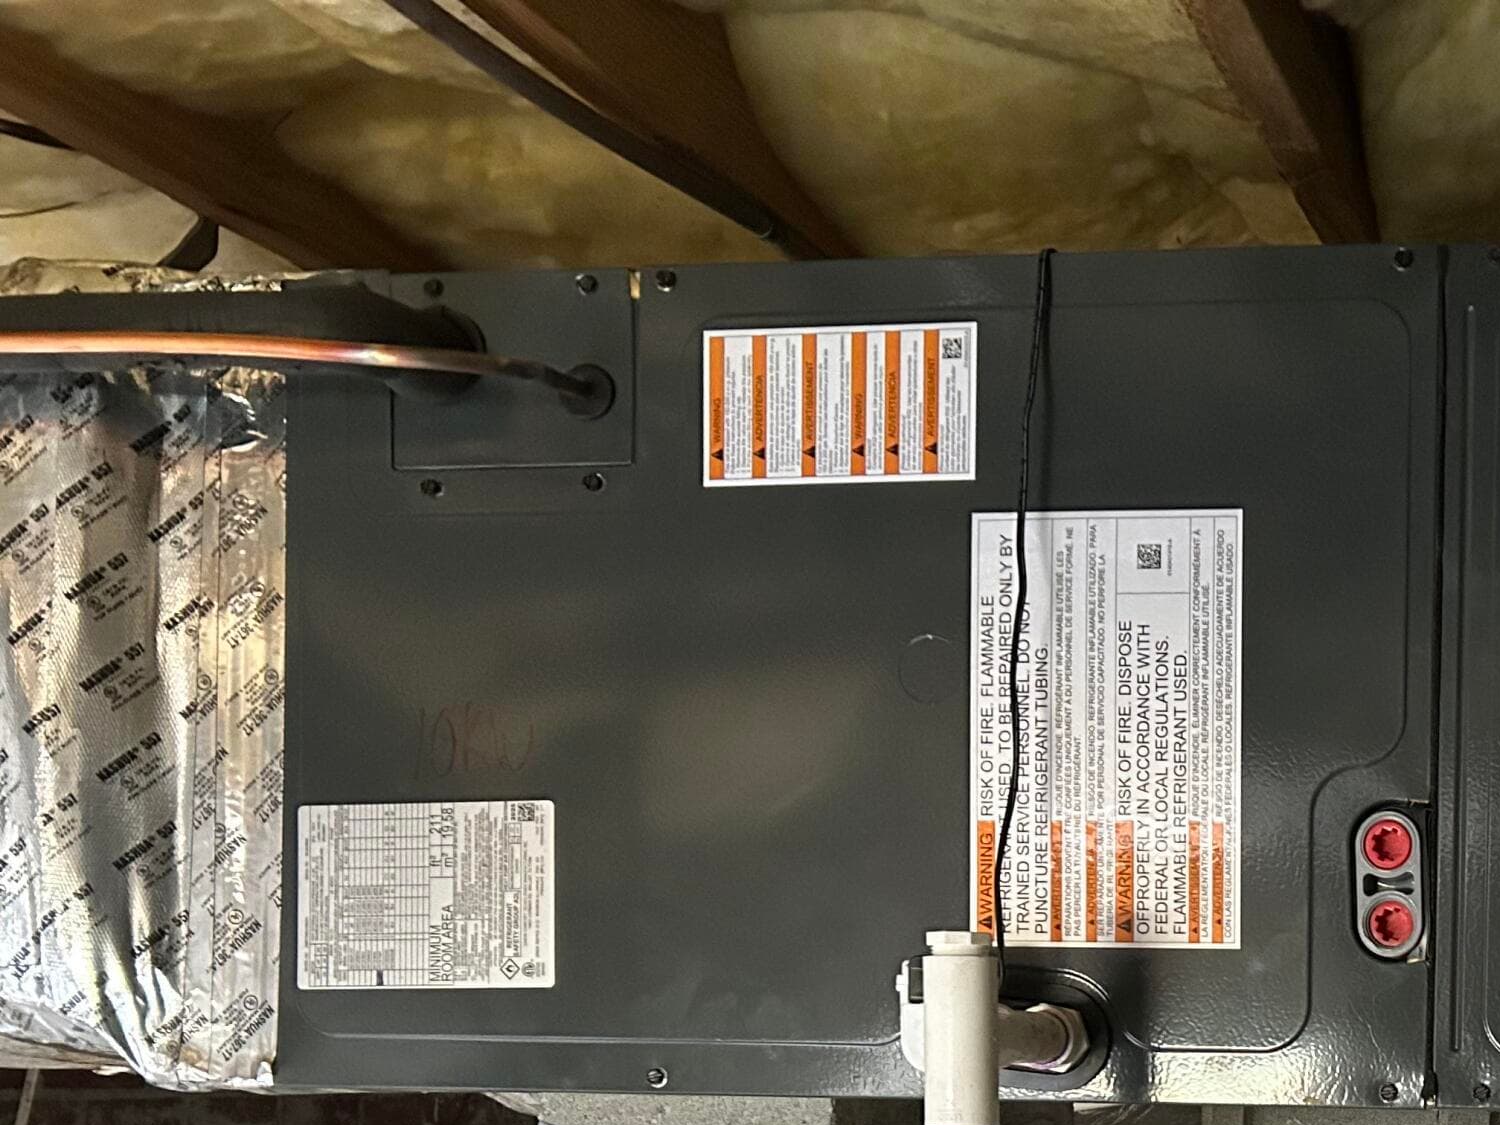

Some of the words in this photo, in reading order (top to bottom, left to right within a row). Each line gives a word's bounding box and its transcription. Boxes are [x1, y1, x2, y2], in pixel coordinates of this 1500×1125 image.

[755, 374, 763, 441] ADVERTENCIA
[805, 361, 813, 440] AVERTISSEMENT
[888, 371, 896, 438] ADVERTENCIA
[927, 357, 935, 436] AVERTISSEMENT
[106, 550, 129, 572] 557
[999, 534, 1012, 556] BY
[999, 560, 1012, 606] ONLY
[123, 640, 145, 662] 557
[981, 595, 993, 696] FLAMMABLE
[998, 612, 1012, 695] REPAIRED
[1017, 639, 1030, 662] DO
[1118, 620, 1131, 695] DISPOSE
[1137, 624, 1150, 667] WITH
[1035, 643, 1048, 709] TUBING.
[1155, 635, 1168, 761] REGULATIONS.
[1174, 650, 1187, 701] USED.
[980, 703, 993, 743] FIRE.
[998, 703, 1011, 723] BE
[1118, 702, 1131, 743] FIRE.
[1137, 673, 1150, 793] ACCORDANCE
[139, 729, 161, 751] 557
[980, 750, 992, 772] OF
[998, 730, 1011, 752] TO
[1118, 750, 1131, 771] OF
[1035, 716, 1048, 835] REFRIGERANT
[1174, 706, 1186, 827] REFRIGERANT
[980, 777, 992, 815] RISK
[1017, 783, 1029, 855] SERVICE
[1118, 777, 1131, 815] RISK
[1136, 798, 1149, 813] IN
[1155, 767, 1168, 821] LOCAL
[155, 819, 177, 839] 557
[430, 814, 440, 834] 211
[1155, 827, 1168, 852] OR
[980, 832, 992, 913] WARNING
[1016, 861, 1029, 933] TRAINED
[1035, 838, 1047, 933] PUNCTURE
[1136, 820, 1149, 934] OFPROPERLY
[1154, 856, 1167, 934] FEDERAL
[1173, 833, 1186, 934] FLAMMABLE
[441, 904, 452, 938] AREA
[430, 925, 440, 981] MINIMUM
[441, 939, 452, 980] ROOM
